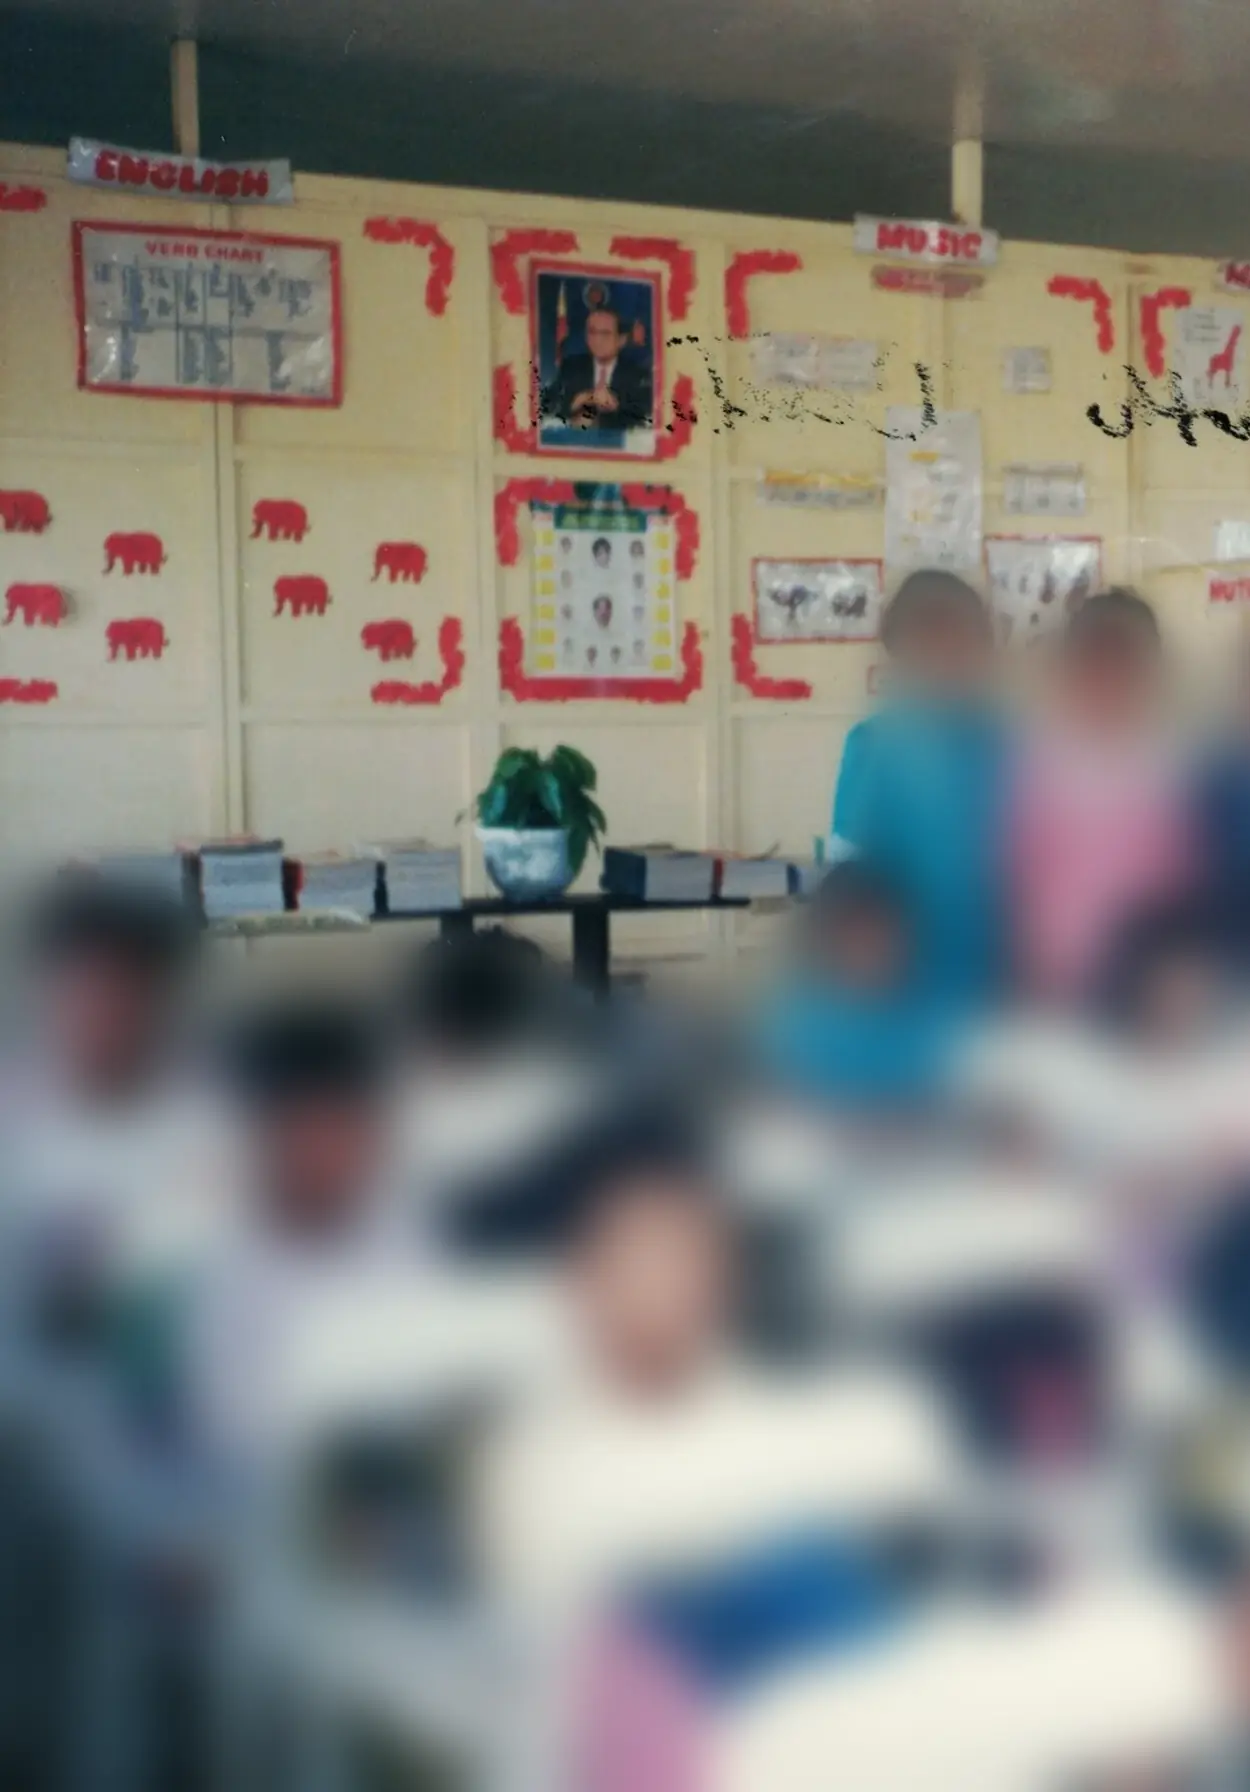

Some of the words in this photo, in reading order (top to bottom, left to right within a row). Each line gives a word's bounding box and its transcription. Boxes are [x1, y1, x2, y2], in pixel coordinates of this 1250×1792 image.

[95, 149, 269, 198] ENGLISH
[146, 242, 198, 258] VERB
[204, 244, 264, 264] CHART
[876, 222, 982, 262] MUSIC
